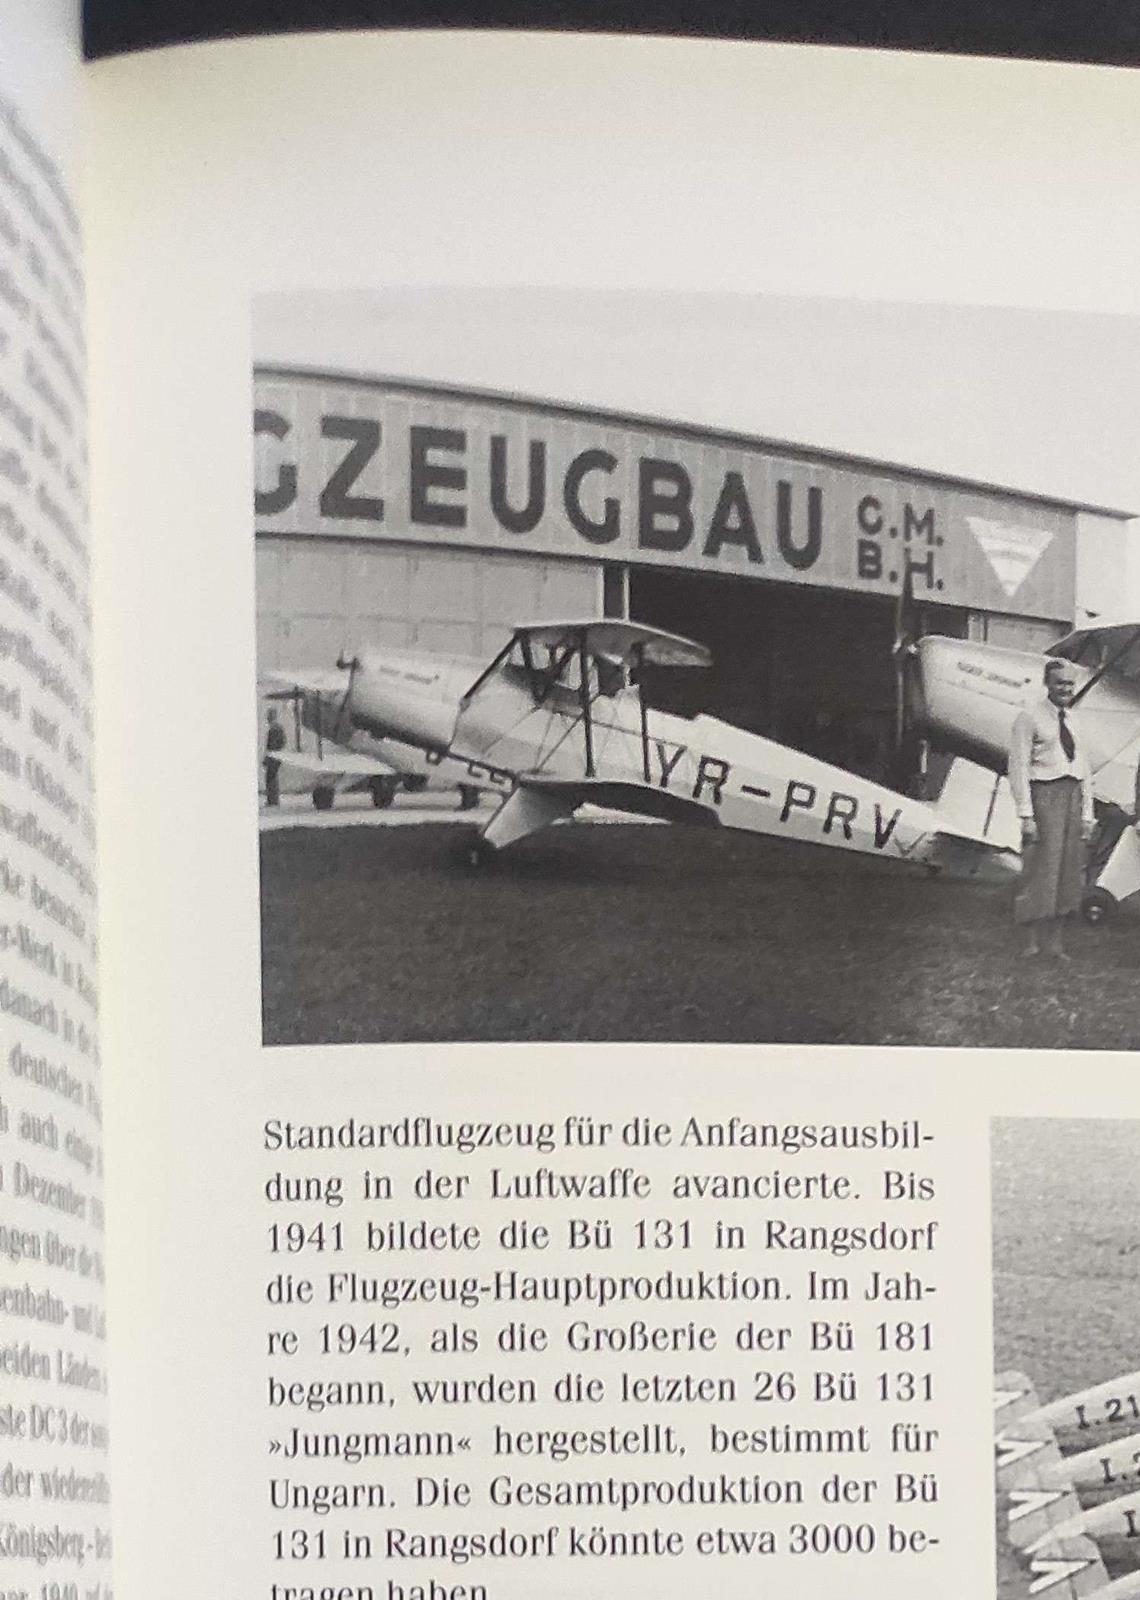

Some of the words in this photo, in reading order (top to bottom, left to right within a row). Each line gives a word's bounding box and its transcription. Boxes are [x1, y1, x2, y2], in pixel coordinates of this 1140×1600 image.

[254, 408, 823, 572] GZEUGBAU
[656, 740, 903, 850] YR-PRV
[264, 1117, 555, 1154] Standardflugzeug
[565, 1116, 612, 1146] für
[622, 1117, 671, 1146] die
[680, 1117, 934, 1154] Anfangsausbil-
[265, 1172, 343, 1207] dung
[364, 1171, 391, 1200] in
[415, 1169, 469, 1199] der
[491, 1168, 651, 1198] Luftwaffe
[673, 1170, 860, 1199] avancierte.
[885, 1171, 934, 1200] Bis
[267, 1274, 313, 1304] die
[329, 1271, 791, 1309] Flugzeug-Hauptproduktion.
[808, 1271, 848, 1300] Im
[864, 1272, 936, 1301] Jah-
[269, 1428, 471, 1463] »Jungmann«
[495, 1424, 685, 1461] hergestellt,
[711, 1424, 869, 1453] bestimmt
[892, 1423, 938, 1452] für
[271, 1479, 395, 1515] Ungarn.
[416, 1477, 470, 1507] Die
[490, 1474, 802, 1512] Gesamtproduktion
[822, 1474, 877, 1503] der
[896, 1474, 937, 1503] Bü
